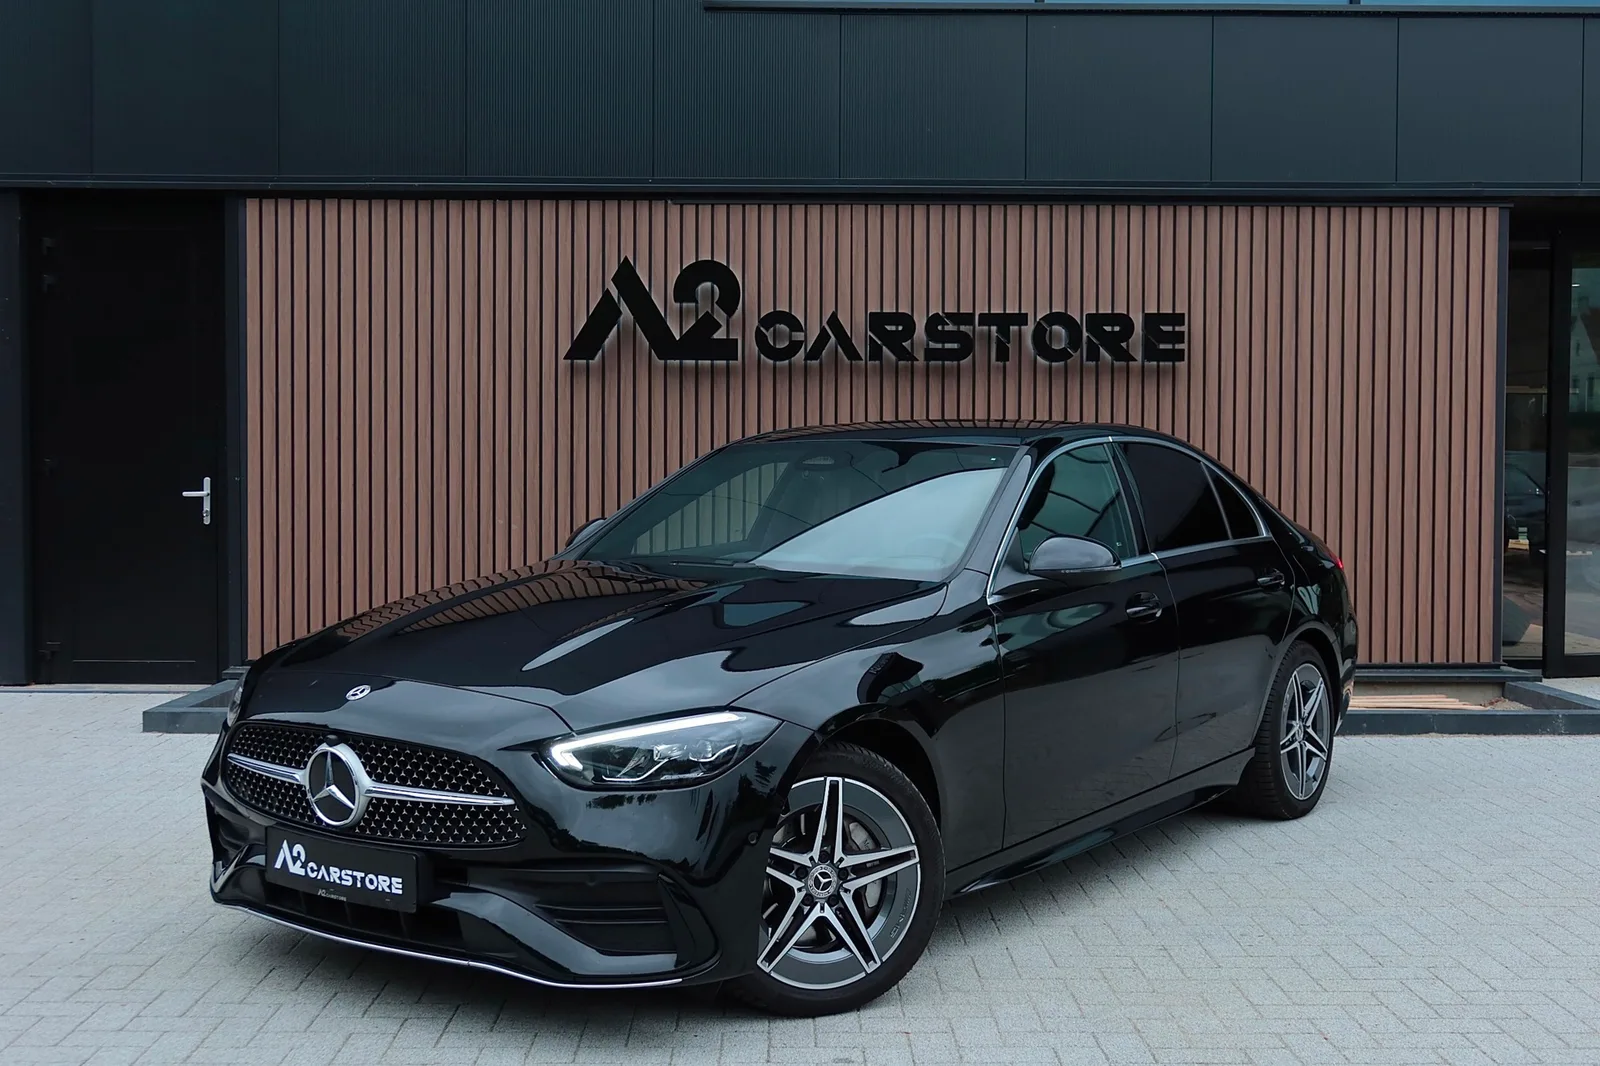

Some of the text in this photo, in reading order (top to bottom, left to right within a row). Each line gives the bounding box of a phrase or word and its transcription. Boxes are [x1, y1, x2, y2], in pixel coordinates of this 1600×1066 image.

[562, 256, 1186, 363] A2 CARSTORE
[274, 839, 402, 894] A2 CARSTORE
